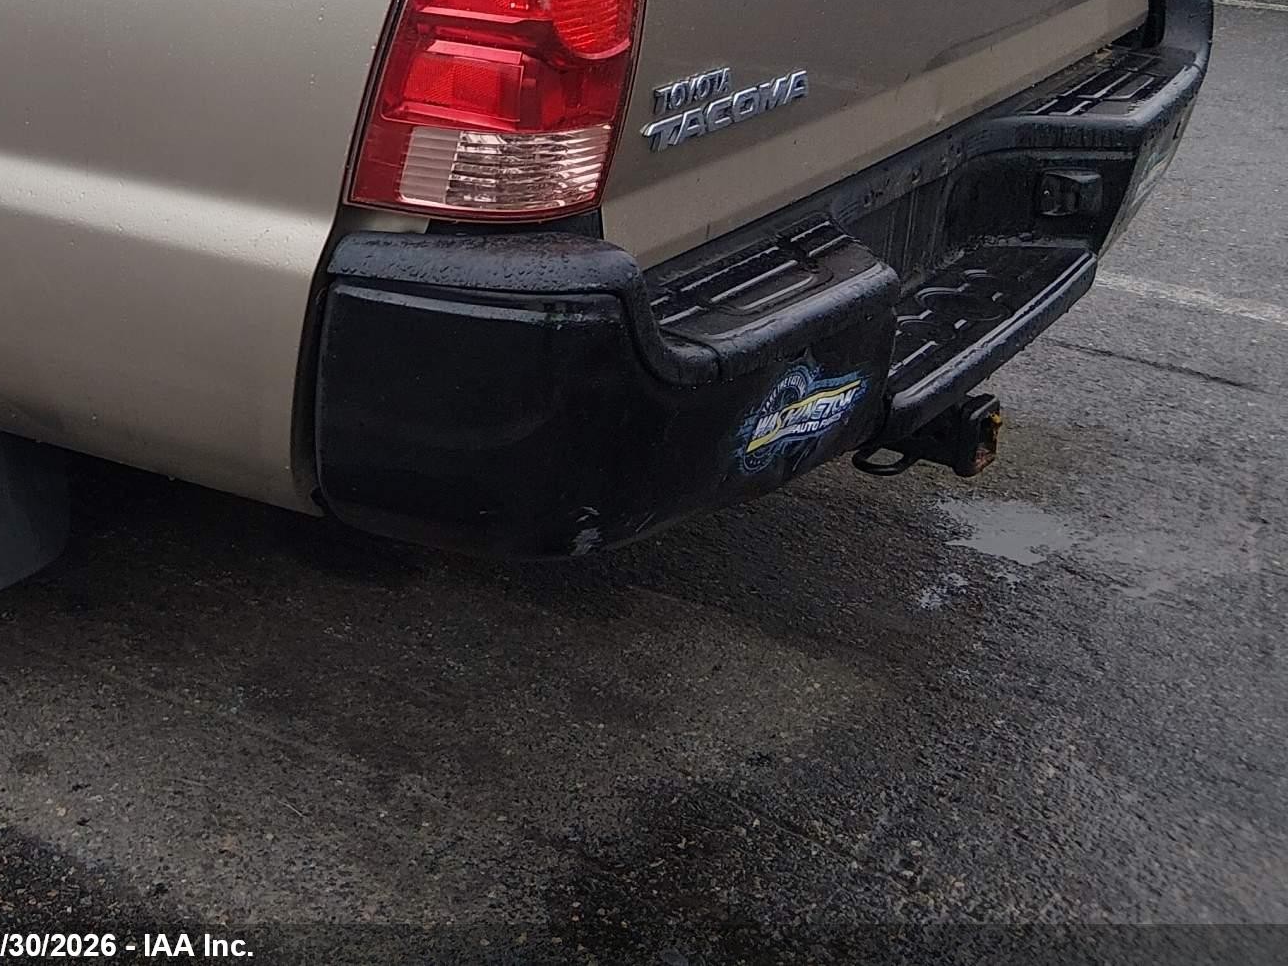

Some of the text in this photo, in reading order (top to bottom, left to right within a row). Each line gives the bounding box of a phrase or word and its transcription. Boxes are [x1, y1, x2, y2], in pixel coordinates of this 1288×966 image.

[640, 69, 810, 152] TACOMA
[652, 66, 732, 115] TOYOTA
[752, 387, 860, 440] WASHINGTON
[793, 421, 819, 434] AUTO
